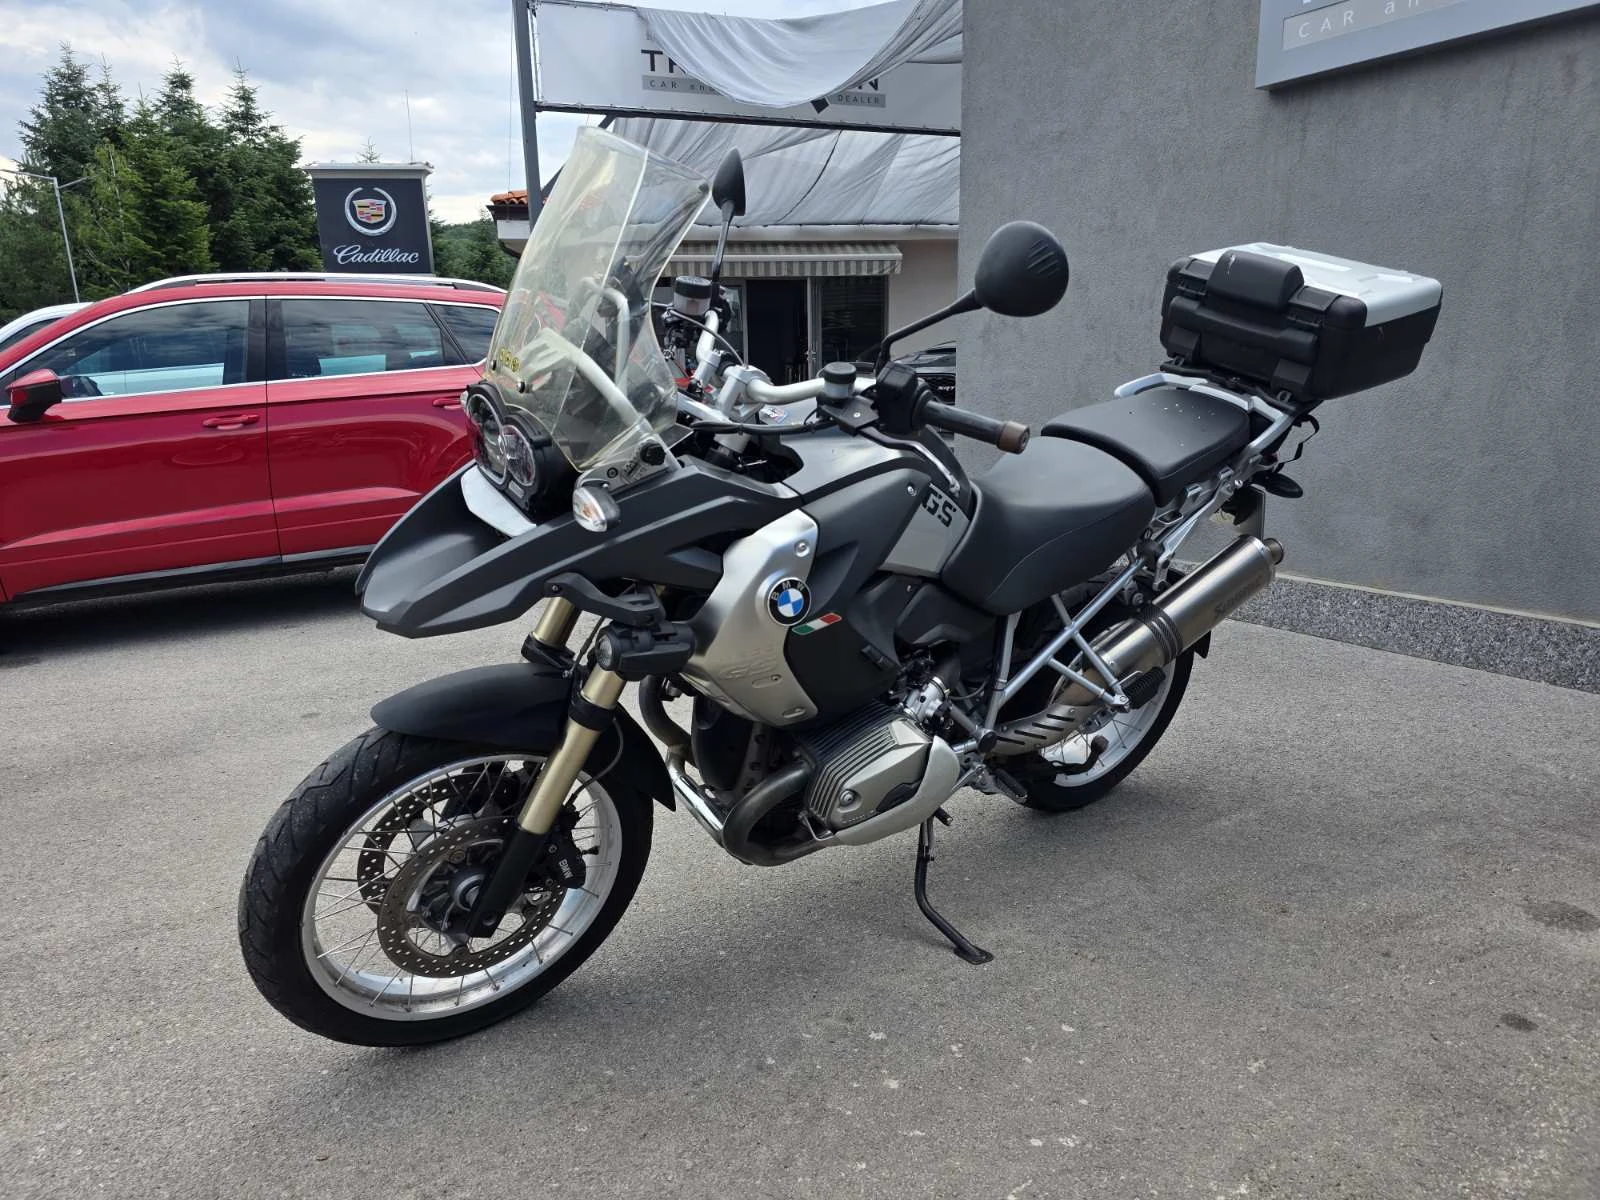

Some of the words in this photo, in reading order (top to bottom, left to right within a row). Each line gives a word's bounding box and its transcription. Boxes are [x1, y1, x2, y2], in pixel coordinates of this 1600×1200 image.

[1297, 10, 1354, 38] CAR
[649, 80, 677, 89] CAR
[837, 94, 880, 104] DEALER
[333, 244, 419, 265] Cadillac
[921, 486, 957, 527] GS
[770, 580, 805, 601] BMW
[559, 859, 574, 879] BMW
